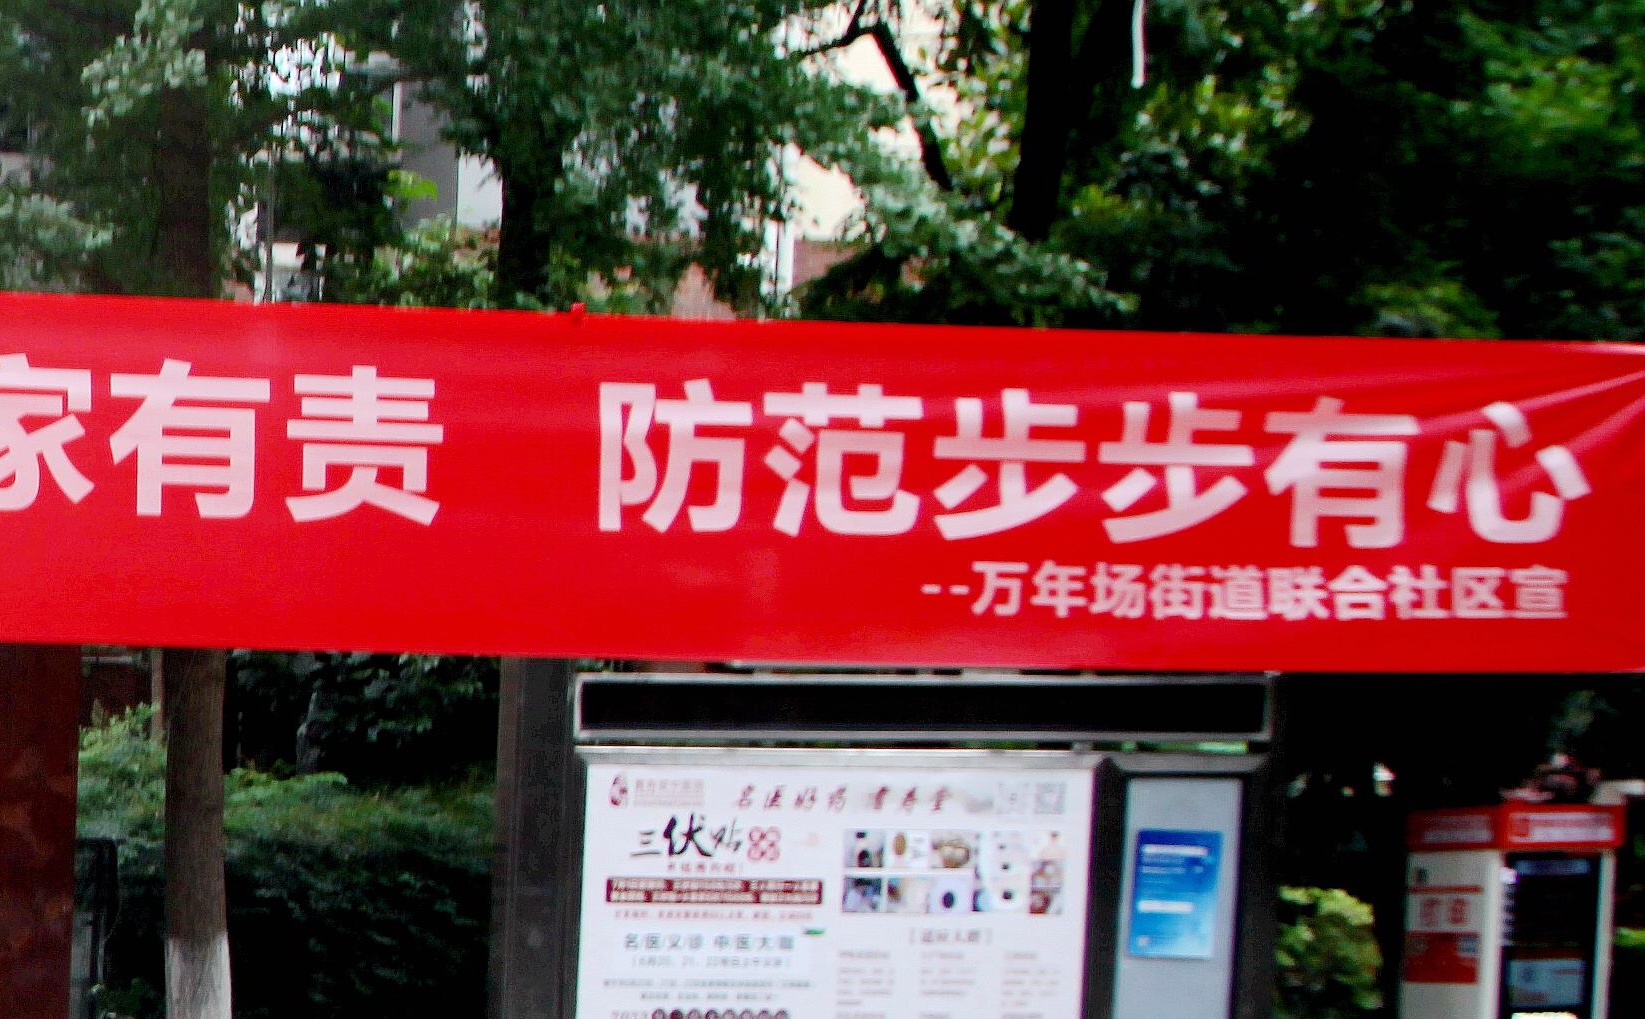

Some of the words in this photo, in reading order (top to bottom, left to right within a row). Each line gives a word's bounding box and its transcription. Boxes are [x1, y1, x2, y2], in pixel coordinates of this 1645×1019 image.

[597, 377, 1591, 548] 防范步步有心
